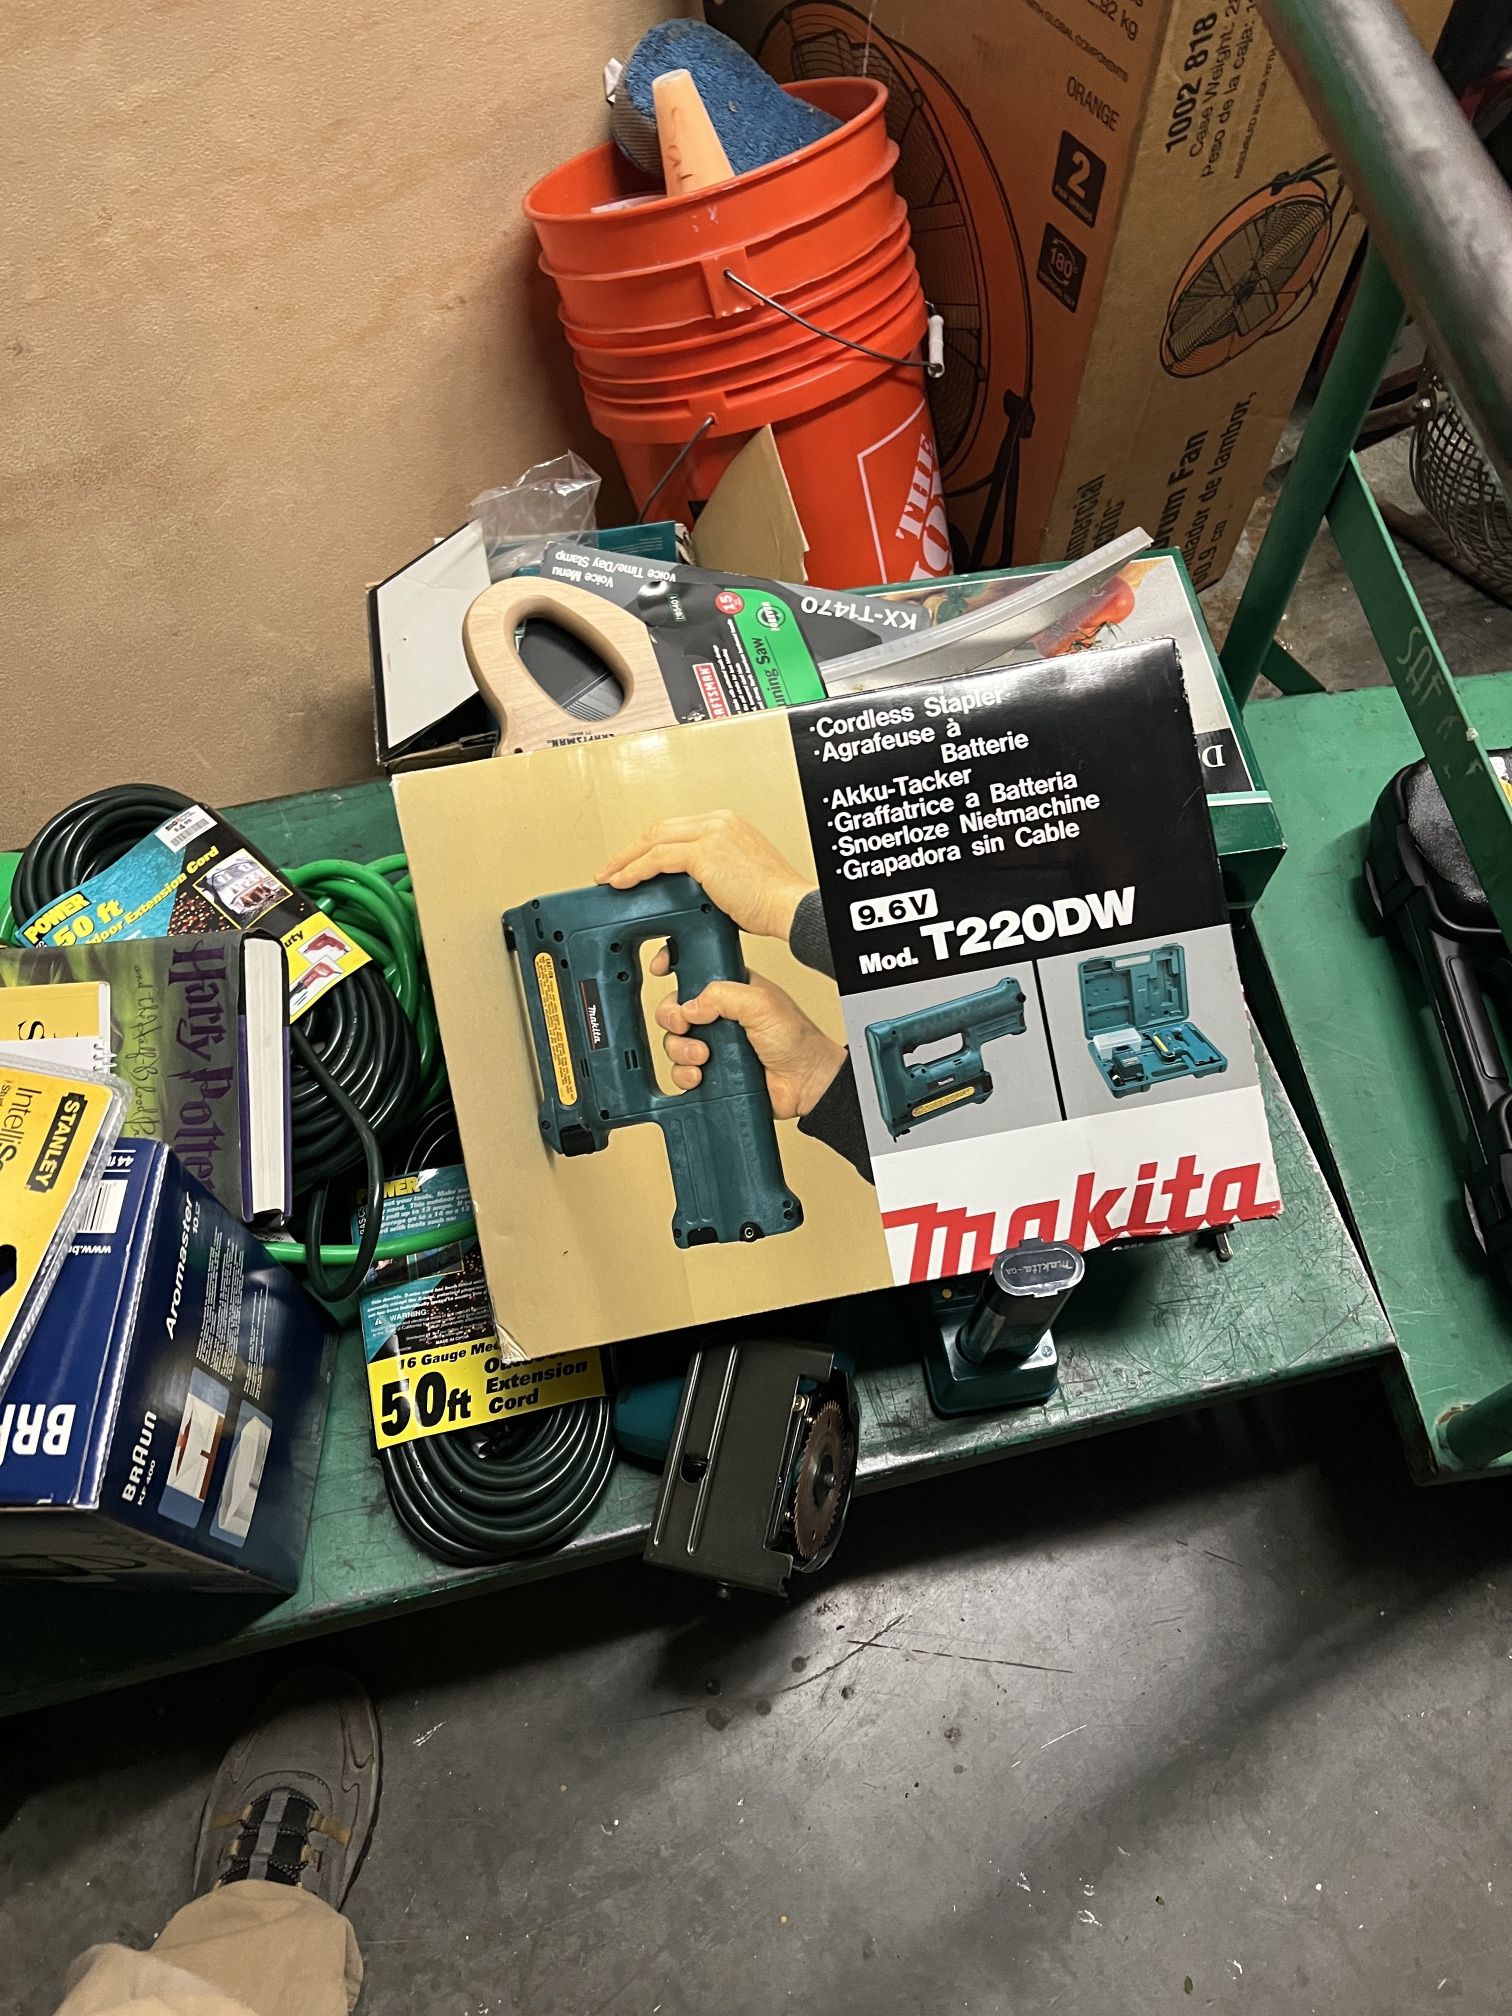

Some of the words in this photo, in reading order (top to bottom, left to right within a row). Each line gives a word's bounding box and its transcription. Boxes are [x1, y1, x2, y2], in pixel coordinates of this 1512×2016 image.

[1120, 9, 1138, 41] kg
[1067, 76, 1119, 132] ORANGE
[1165, 77, 1202, 153] 1002
[1184, 12, 1218, 72] 818
[1223, 74, 1241, 95] la
[1189, 106, 1214, 157] Case
[1218, 99, 1234, 124] de
[1067, 151, 1091, 199] 2
[1201, 129, 1226, 178] Peso
[1167, 430, 1208, 486] Fan
[895, 433, 933, 540] THE
[1198, 477, 1222, 502] de
[1211, 520, 1228, 543] cm
[552, 566, 582, 582] Menu
[555, 550, 590, 568] Stamp
[584, 572, 613, 588] Voice
[592, 557, 643, 578] Time/Day
[647, 568, 676, 582] Voice
[801, 596, 917, 630] KX-T1470
[752, 637, 770, 665] Saw
[816, 704, 915, 738] Cordless
[923, 689, 1003, 718] Stapler
[822, 725, 935, 763] Agrafeuse
[946, 718, 961, 738] à
[940, 731, 1029, 764] Batterie
[830, 767, 973, 810] Akku-Tacker
[834, 796, 954, 833] Graffatrice
[965, 791, 980, 809] a
[989, 770, 1078, 804] Batteria
[838, 822, 950, 857] Snoerloze
[959, 792, 1101, 834] Nietmachine
[843, 844, 961, 881] Grapadora
[972, 835, 1005, 857] sin
[1015, 819, 1080, 848] Cable
[125, 873, 188, 924] Extension
[187, 846, 220, 876] Cord
[23, 893, 92, 945] POWER
[53, 917, 94, 947] 50
[97, 899, 125, 923] ft
[857, 893, 929, 926] 9.6V
[859, 947, 920, 975] Mod.
[919, 886, 1136, 961] T220DW
[134, 965, 154, 989] and
[168, 940, 227, 1062] Harry
[35, 1099, 81, 1187] STANLEY
[167, 1066, 234, 1192] Potter
[881, 1154, 1281, 1284] makita
[165, 1191, 193, 1341] Aromaster
[389, 1308, 430, 1322] WARNING:
[400, 1357, 416, 1370] 16
[421, 1348, 466, 1366] Gauge
[486, 1359, 588, 1395] Extension
[488, 1388, 539, 1414] Cord
[137, 1486, 147, 1506] KF
[146, 1460, 156, 1484] 400
